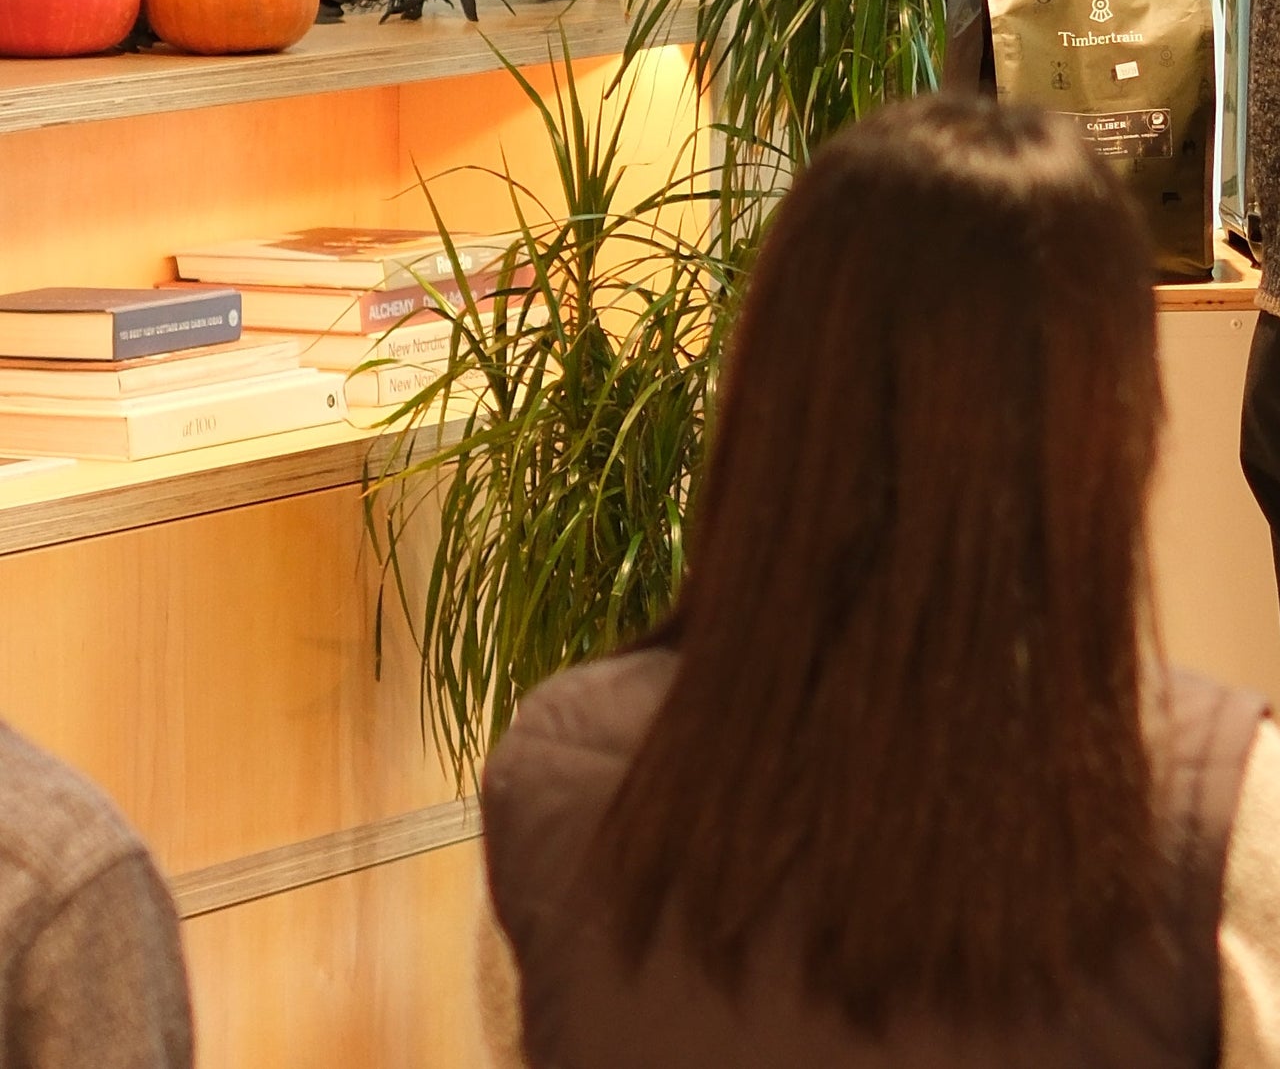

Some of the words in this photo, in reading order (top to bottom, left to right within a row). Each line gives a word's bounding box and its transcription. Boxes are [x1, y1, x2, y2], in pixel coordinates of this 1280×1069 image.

[1057, 31, 1143, 47] Timbertrain
[1086, 121, 1127, 131] CALIBER
[368, 298, 414, 321] ALCHEMY
[388, 341, 412, 359] New
[412, 335, 446, 356] Nordic
[389, 377, 412, 394] New
